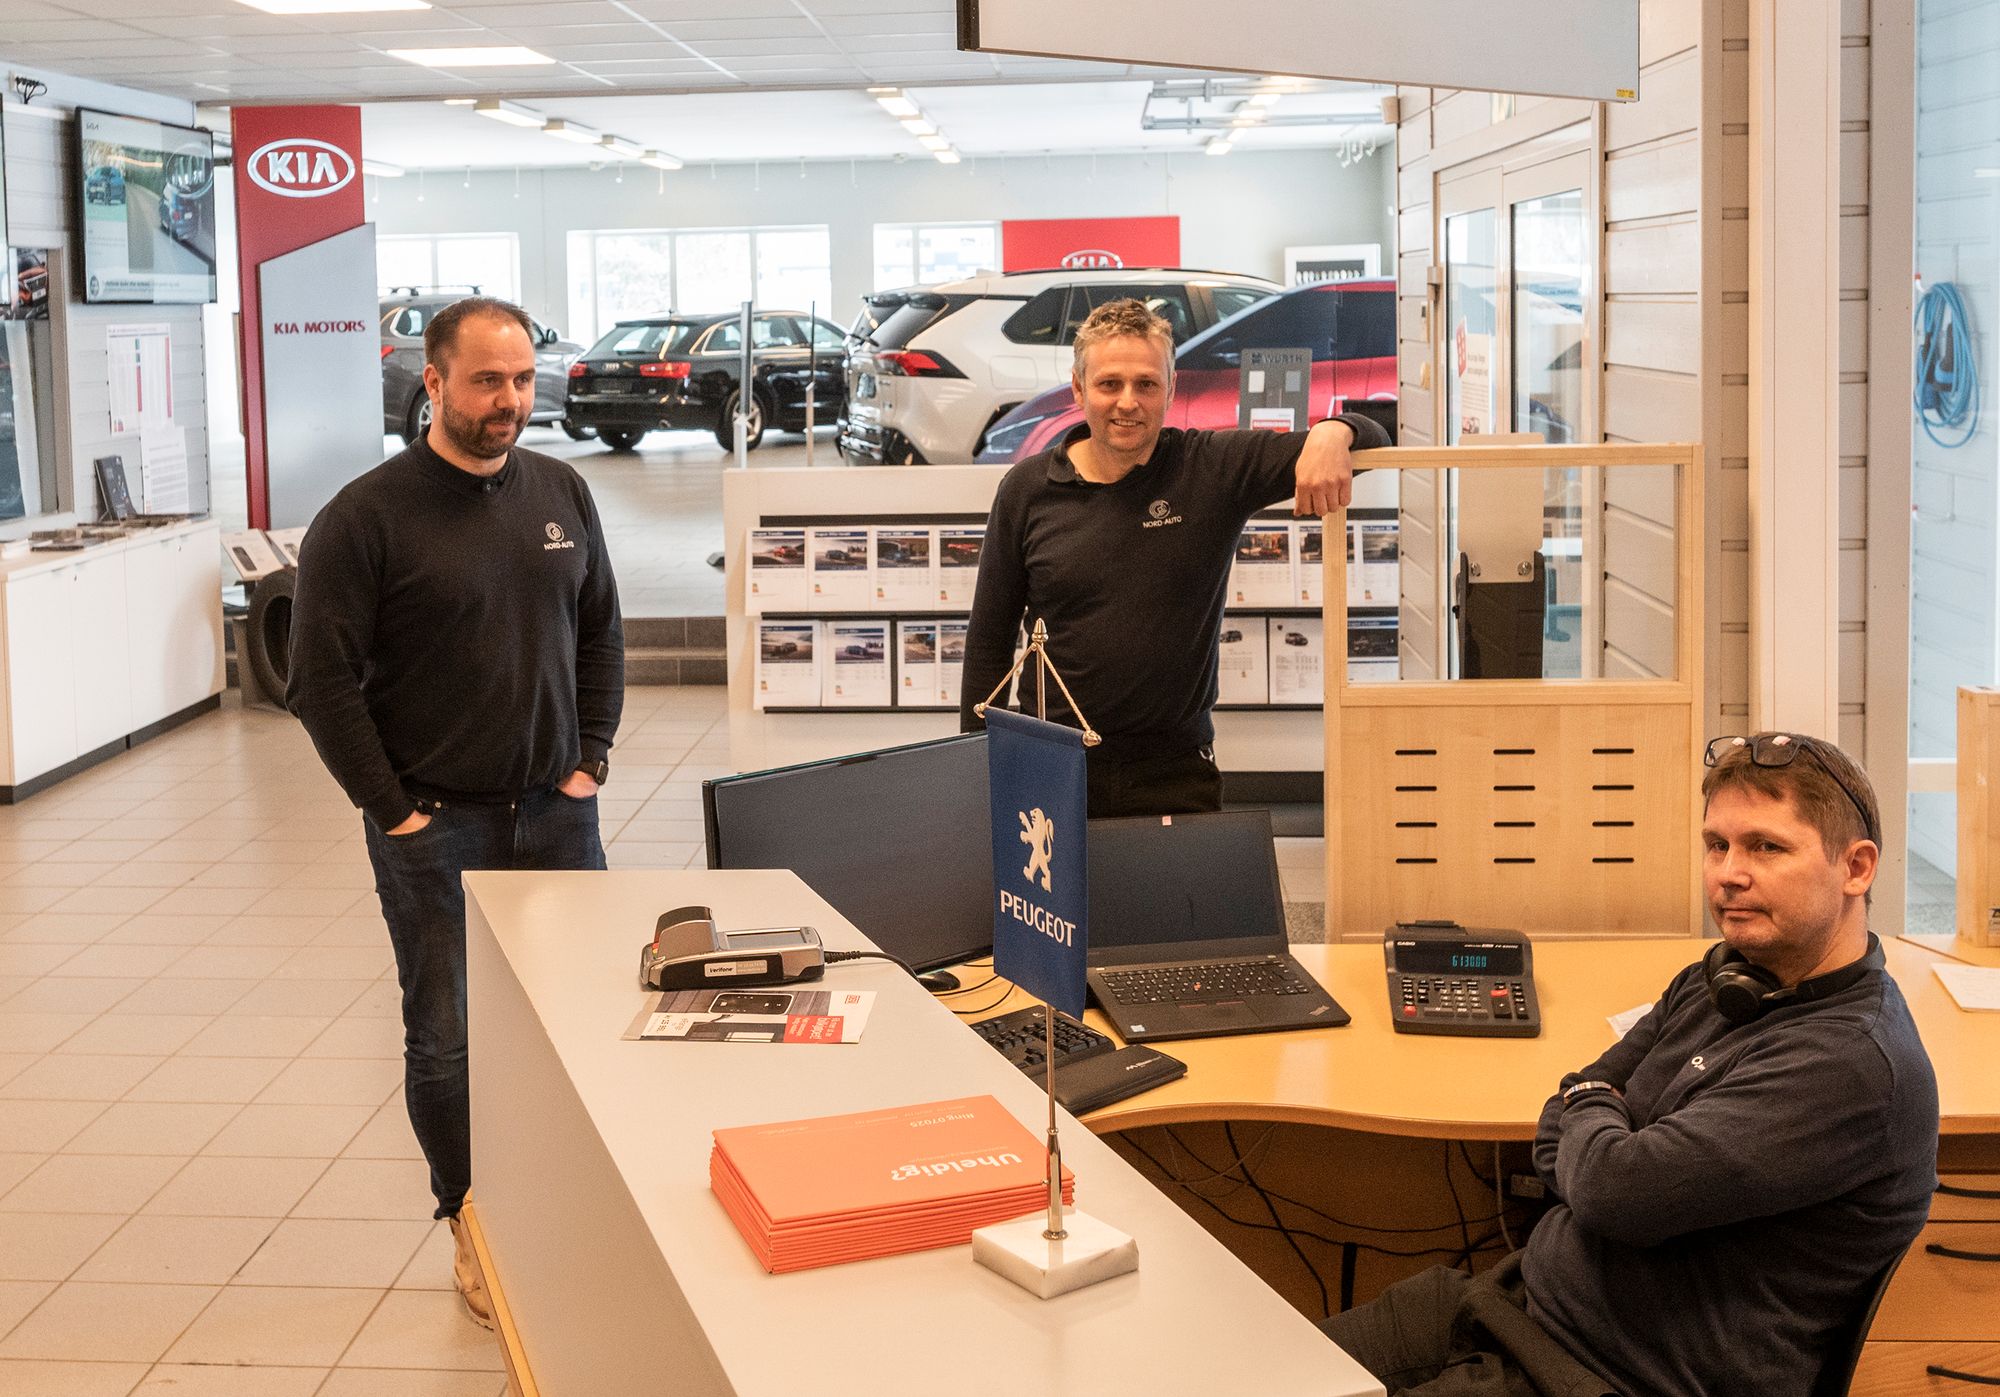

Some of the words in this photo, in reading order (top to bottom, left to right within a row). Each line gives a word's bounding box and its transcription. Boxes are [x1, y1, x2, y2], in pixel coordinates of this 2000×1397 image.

[267, 151, 339, 184] KIA
[1070, 255, 1110, 269] KIA
[274, 321, 300, 334] KIA
[303, 320, 366, 333] MOTORS
[1000, 889, 1076, 947] PEUGEOT
[945, 1112, 975, 1122] Ring
[890, 1152, 1023, 1181] Uheldig?
